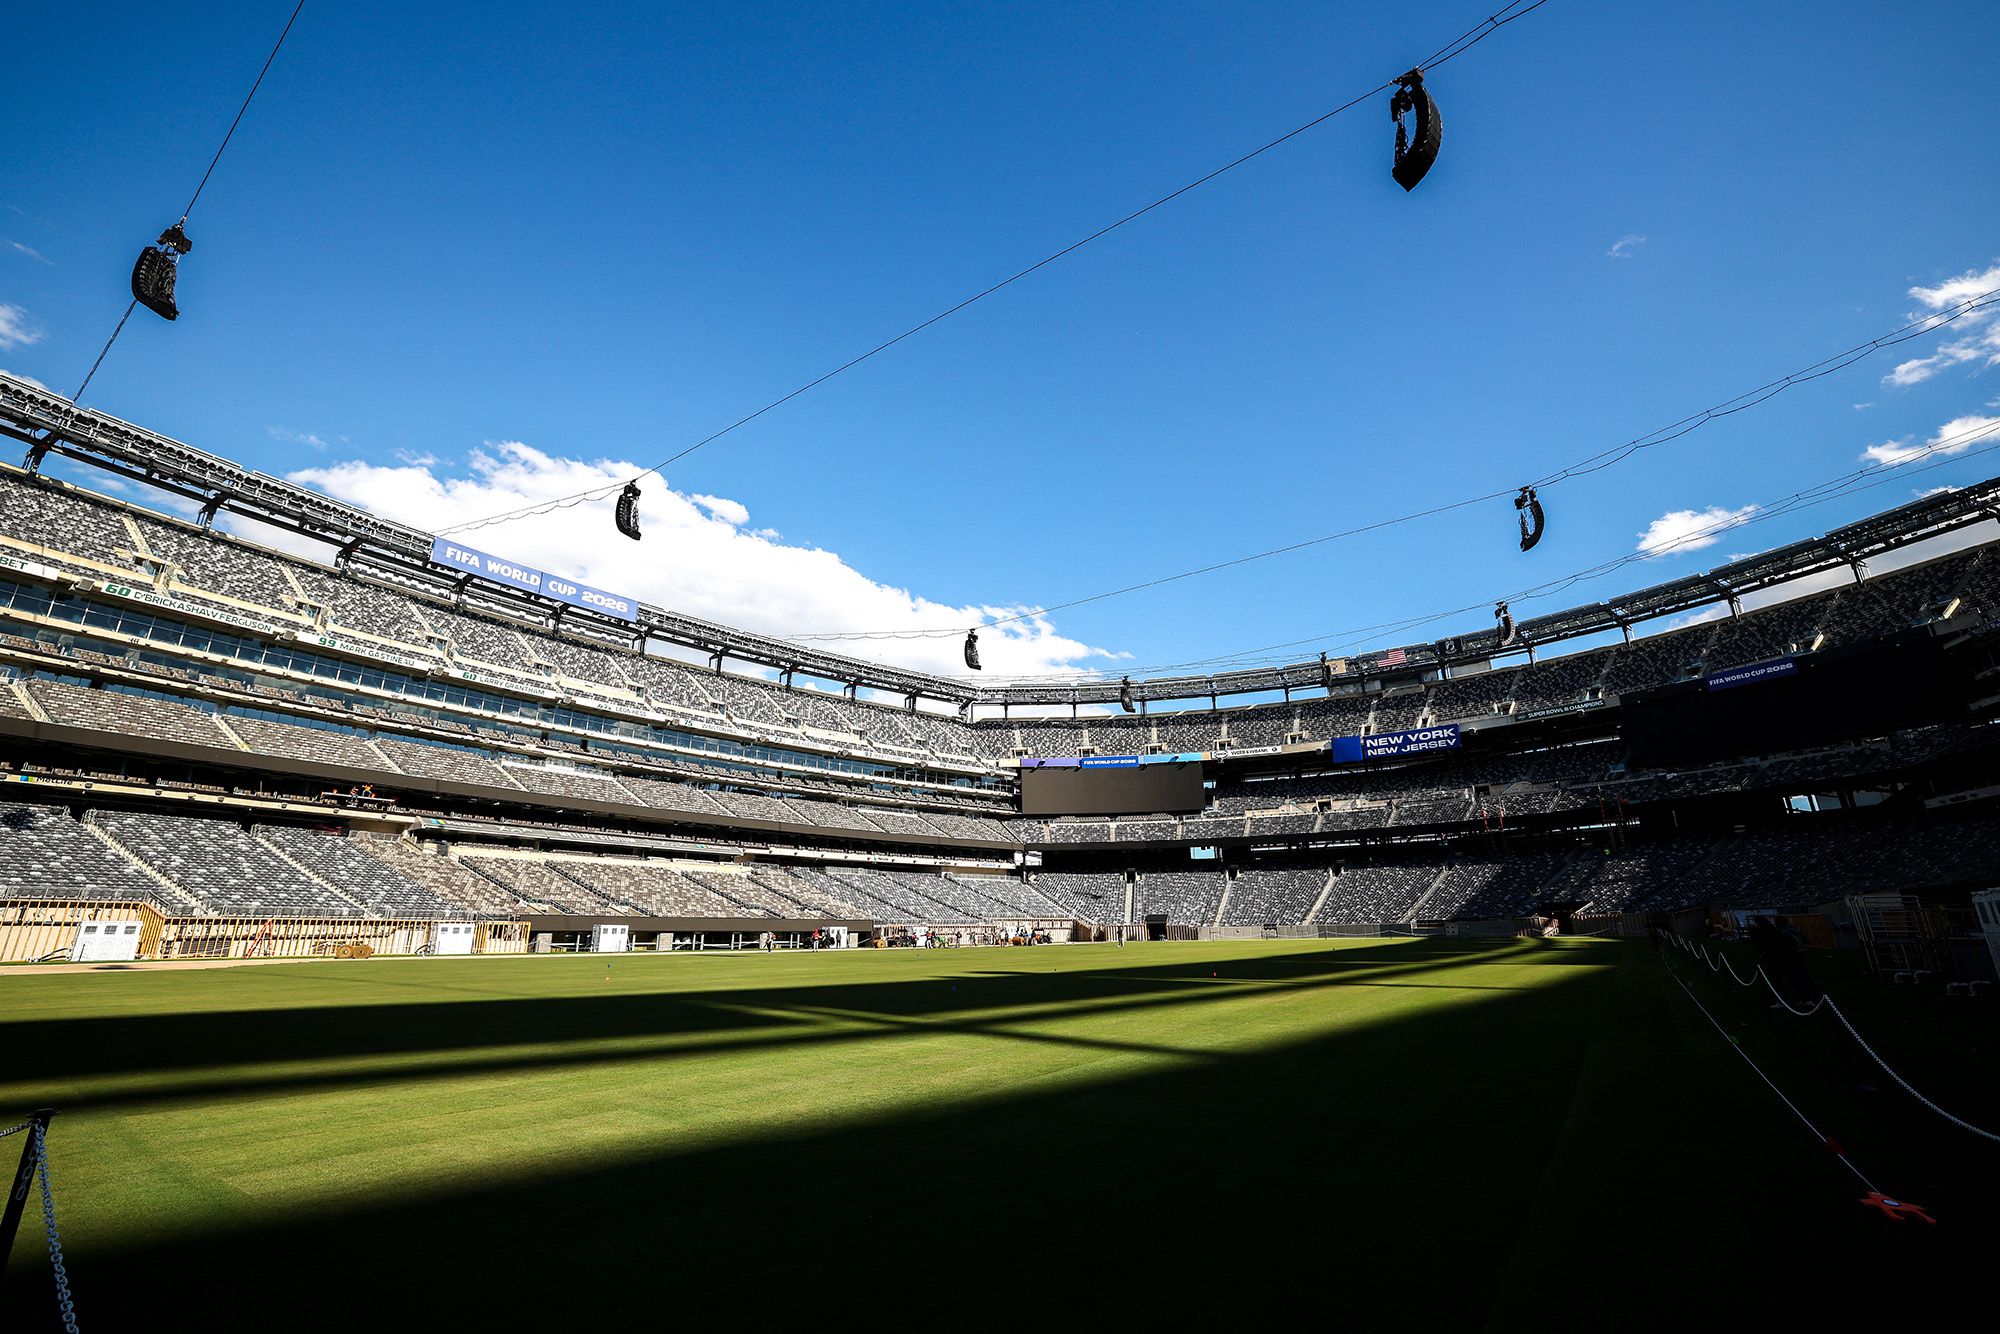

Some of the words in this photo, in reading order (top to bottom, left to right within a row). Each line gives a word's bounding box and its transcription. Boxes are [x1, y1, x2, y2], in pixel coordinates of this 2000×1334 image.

[446, 547, 480, 568] FIFA
[487, 560, 540, 586] WORLD
[548, 580, 576, 597] CUP
[581, 591, 629, 613] 2026
[106, 584, 131, 597] 60
[219, 613, 272, 633] FERGUSON
[318, 637, 337, 648] 99
[340, 643, 367, 655] MARK
[368, 650, 415, 667] GASTINEAU
[1709, 678, 1725, 686] FIFA
[1725, 672, 1751, 682] WORLD
[1751, 668, 1766, 677] CUP
[1766, 662, 1793, 673] 2026
[480, 676, 504, 687] LARRY
[505, 682, 545, 696] GRANTHAM
[615, 706, 631, 714] LEON
[1528, 709, 1546, 719] SUPER
[1546, 707, 1563, 715] BOWL
[1569, 700, 1604, 711] CHAMPIONS
[1366, 735, 1404, 748] NEW
[1407, 727, 1456, 742] YORK
[1367, 746, 1399, 757] NEW
[1401, 738, 1457, 753] JERSEY
